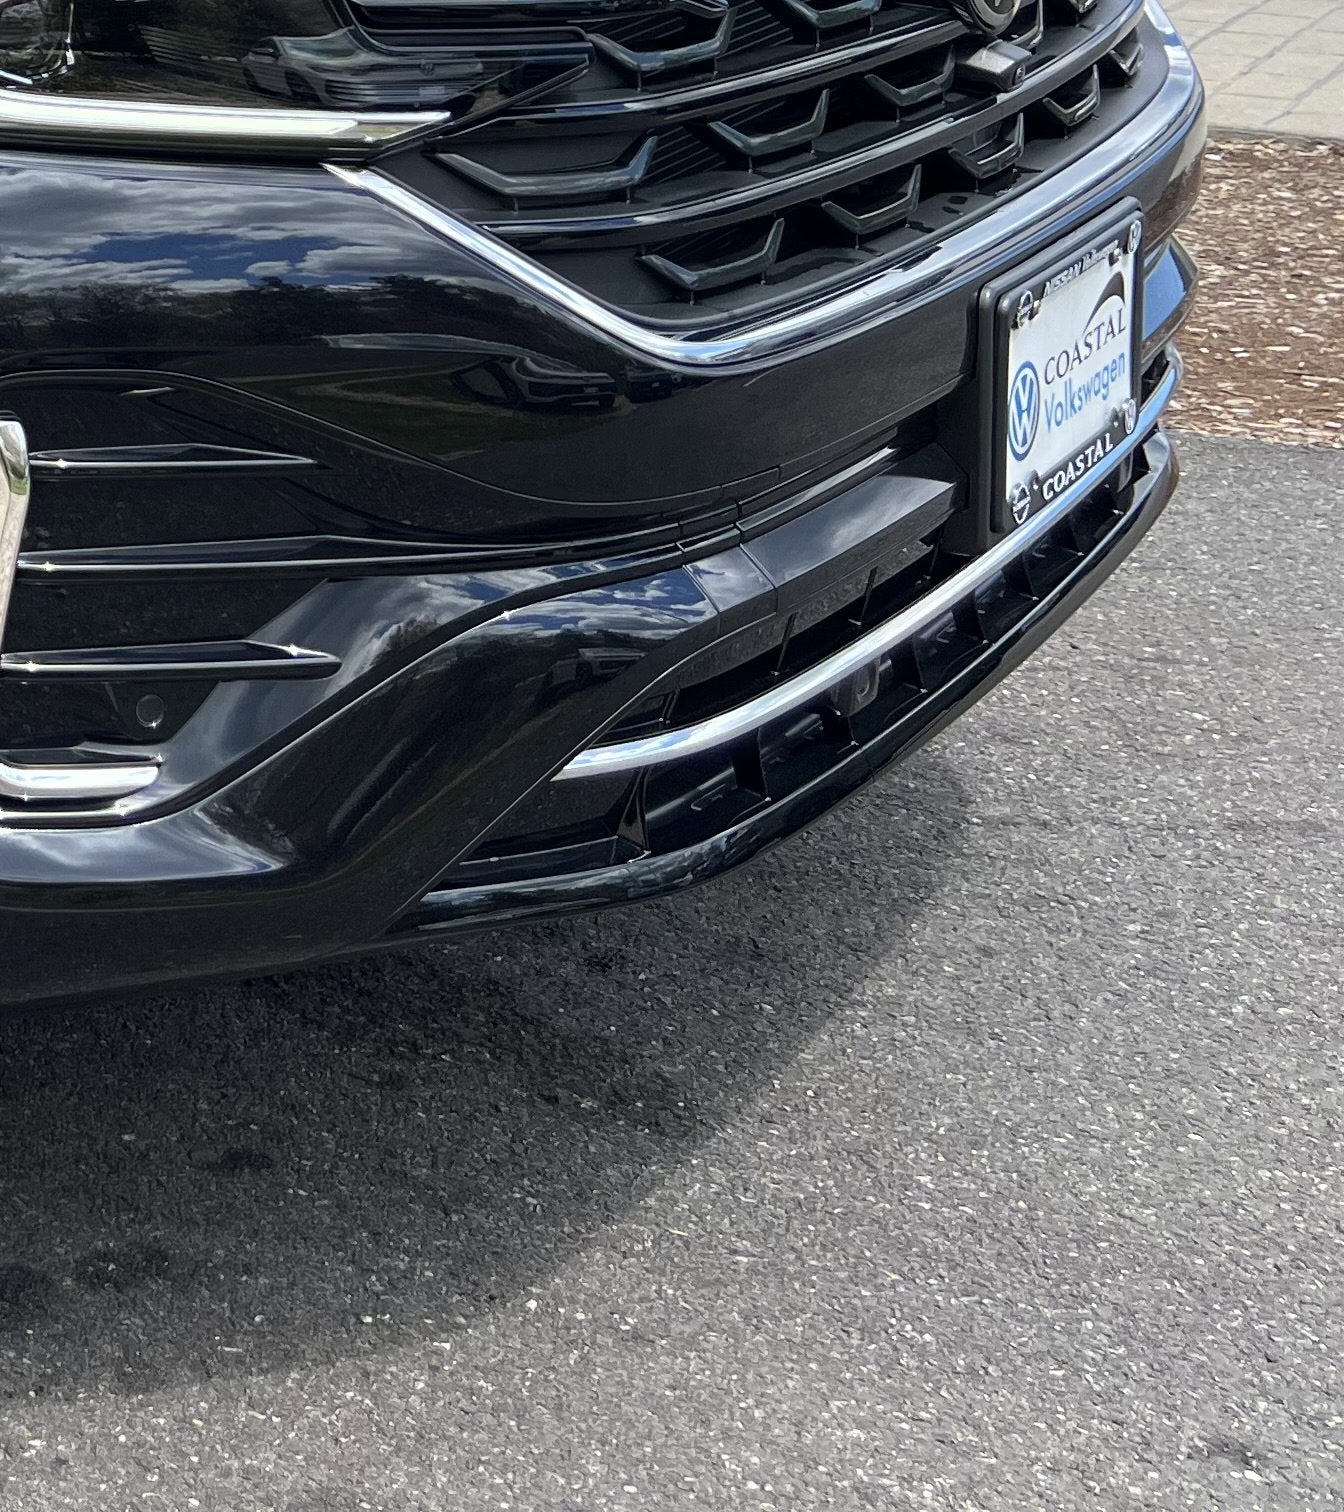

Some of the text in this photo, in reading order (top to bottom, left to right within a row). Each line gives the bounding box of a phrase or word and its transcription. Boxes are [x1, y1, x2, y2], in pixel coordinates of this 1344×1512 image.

[1044, 307, 1126, 385] COASTAL
[1044, 352, 1126, 434] Volkswagen
[1042, 432, 1113, 501] COASTAL
